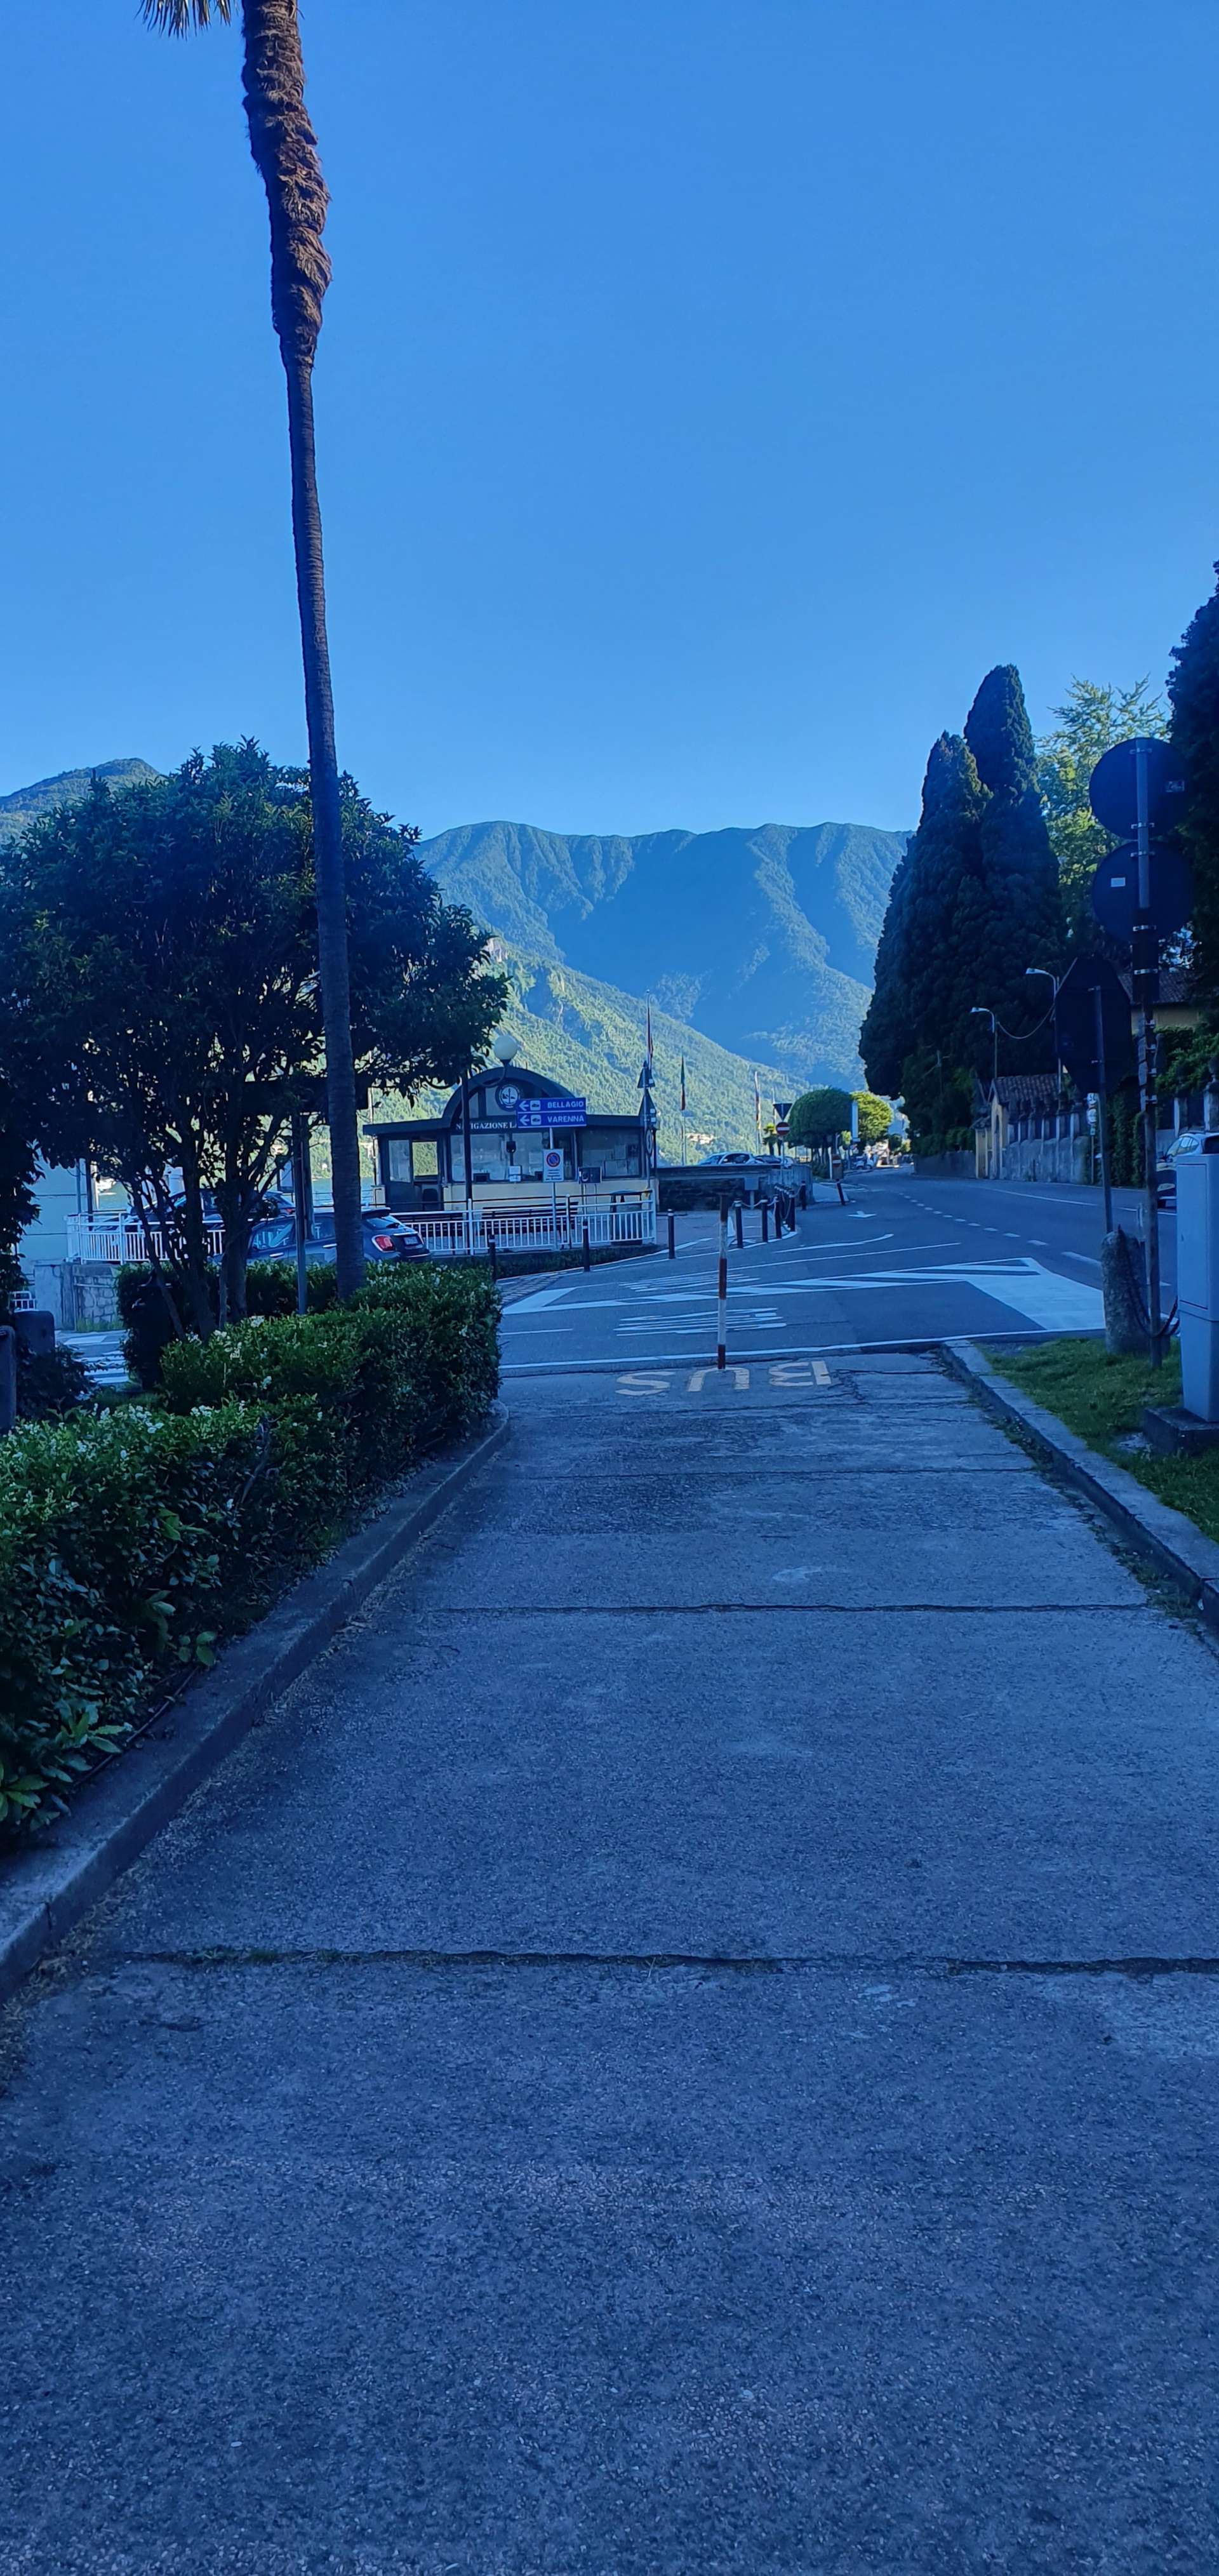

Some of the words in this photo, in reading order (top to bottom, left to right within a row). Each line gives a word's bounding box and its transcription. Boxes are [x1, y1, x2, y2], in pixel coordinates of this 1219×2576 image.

[547, 1100, 584, 1109] BELLAGIO
[547, 1114, 585, 1123] VARENNA
[615, 1360, 832, 1396] BUS
